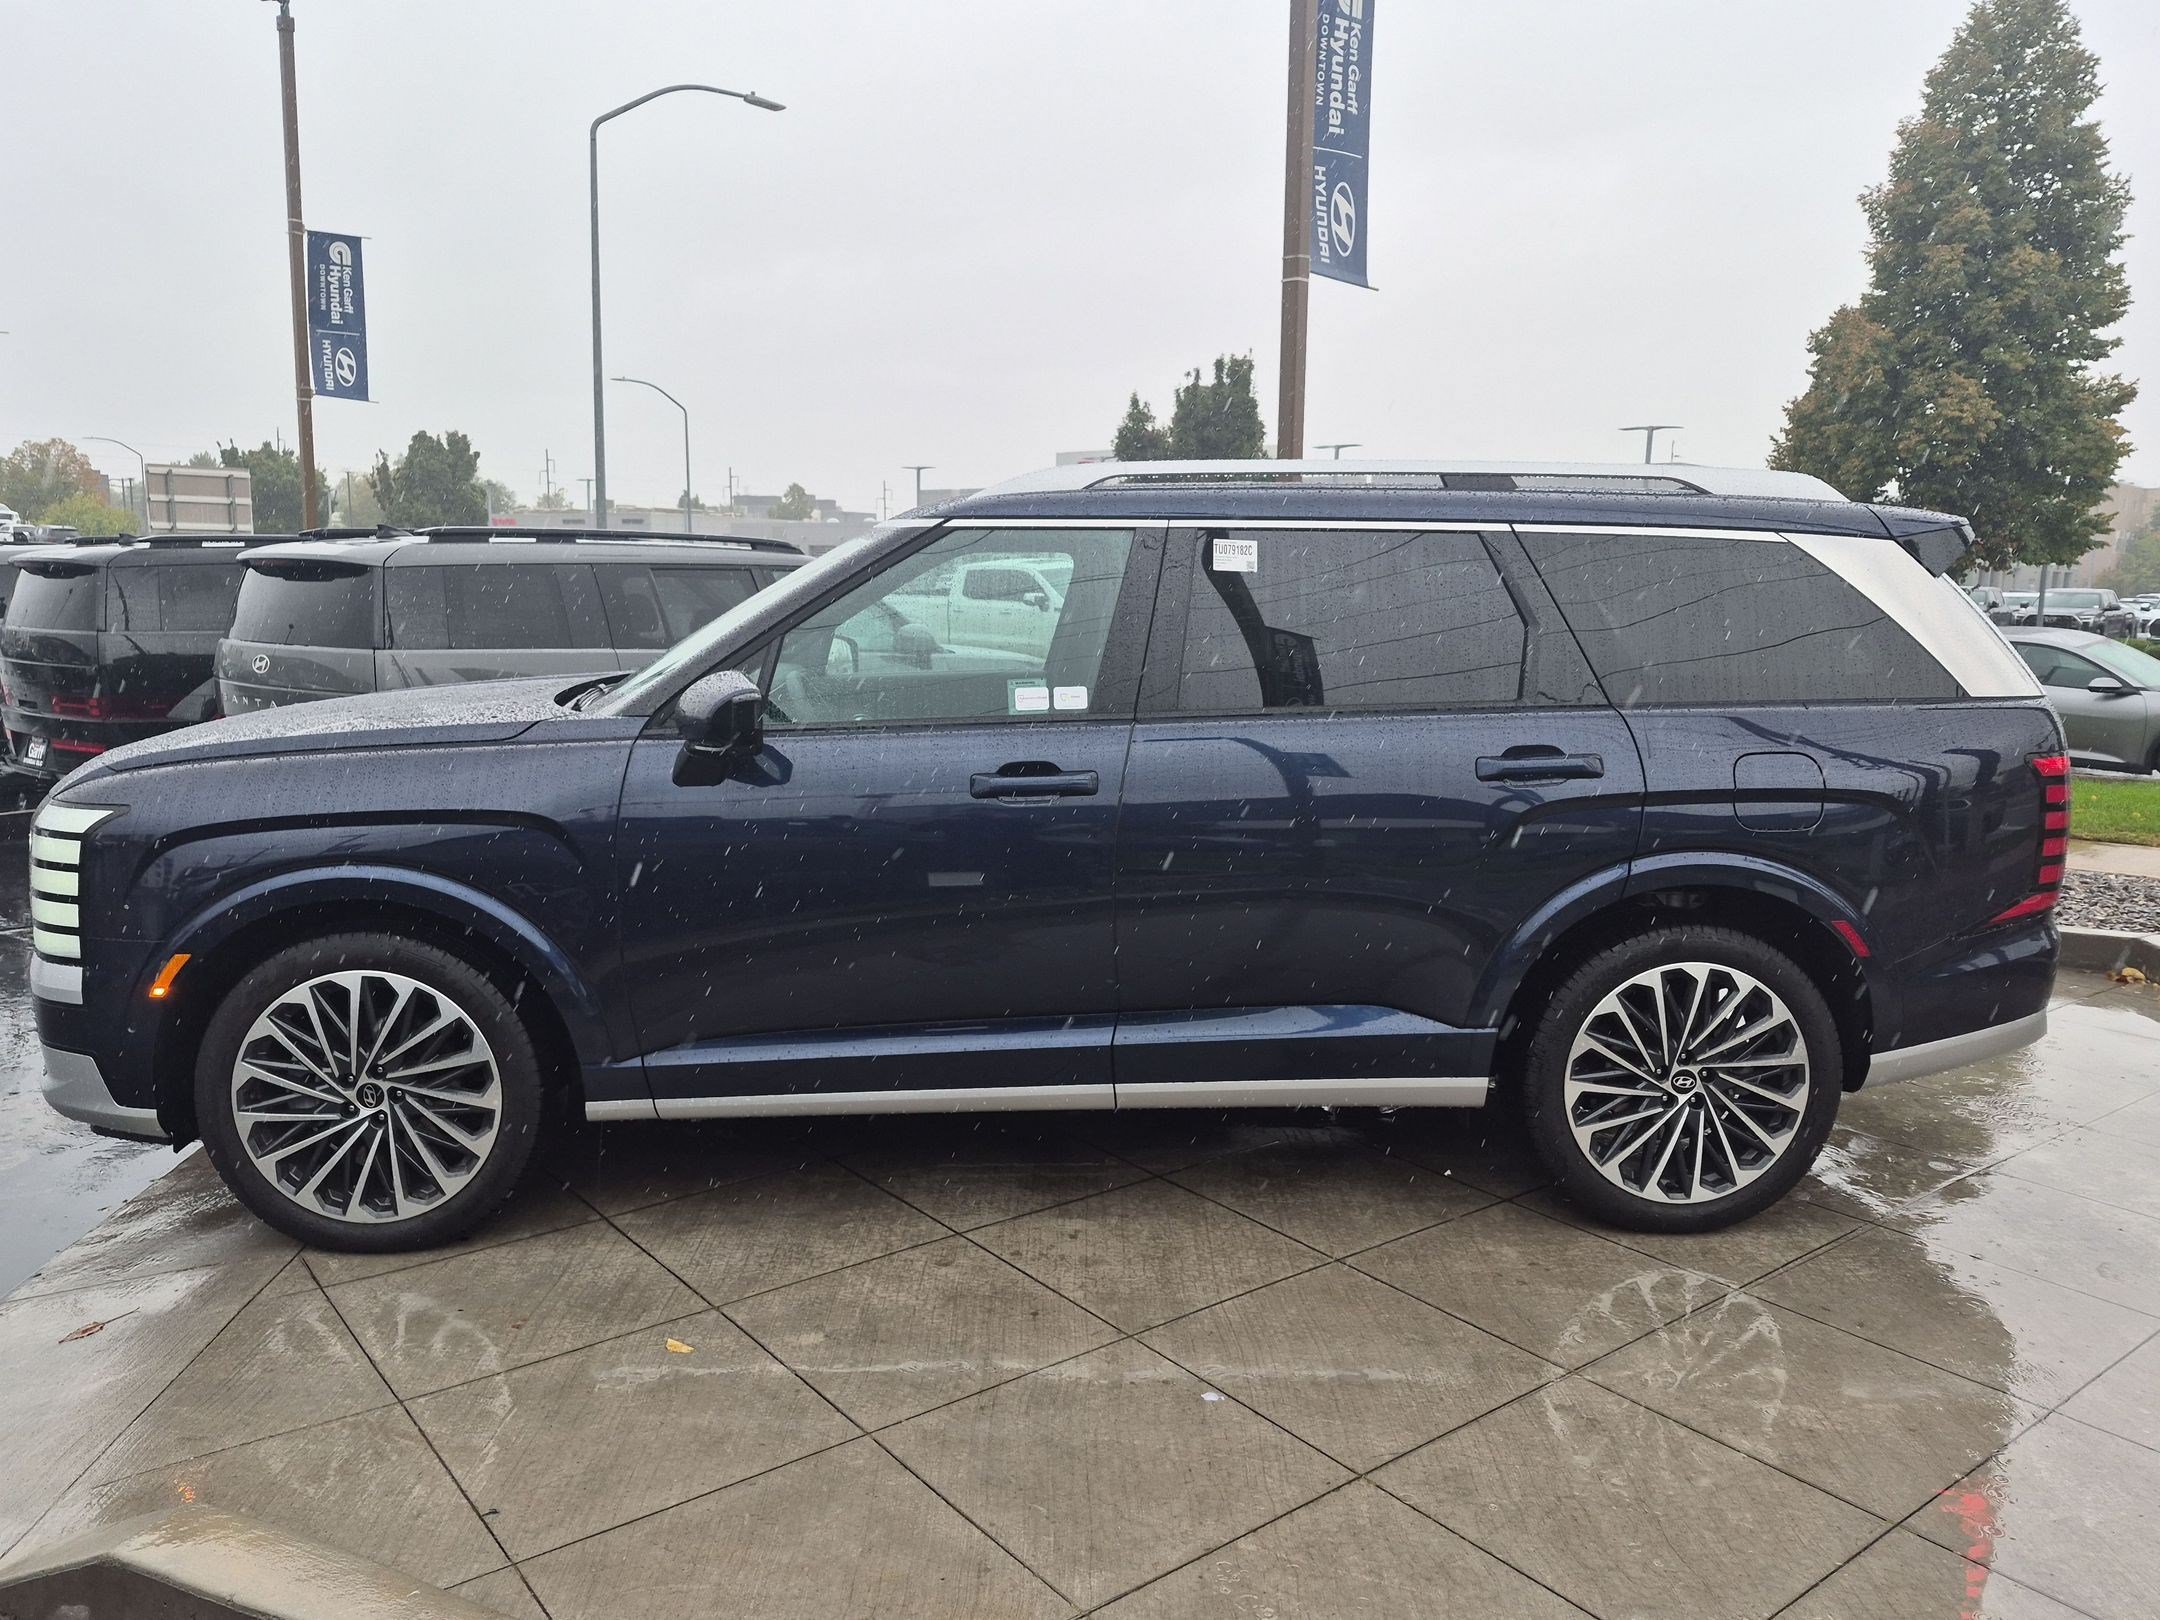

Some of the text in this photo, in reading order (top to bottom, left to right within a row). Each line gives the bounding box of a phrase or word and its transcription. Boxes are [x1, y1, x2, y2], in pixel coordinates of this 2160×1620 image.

[1315, 13, 1330, 106] DOWNTOWN
[1328, 17, 1350, 135] Hyundai
[1346, 22, 1362, 115] Ken Garff
[1314, 165, 1331, 264] HYUNDAI
[319, 263, 327, 311] DOWNTOWN
[327, 265, 344, 324] Hyundai
[342, 266, 354, 314] Ken Garff
[322, 339, 335, 391] HYUNDAI
[1214, 543, 1253, 556] TU079182C
